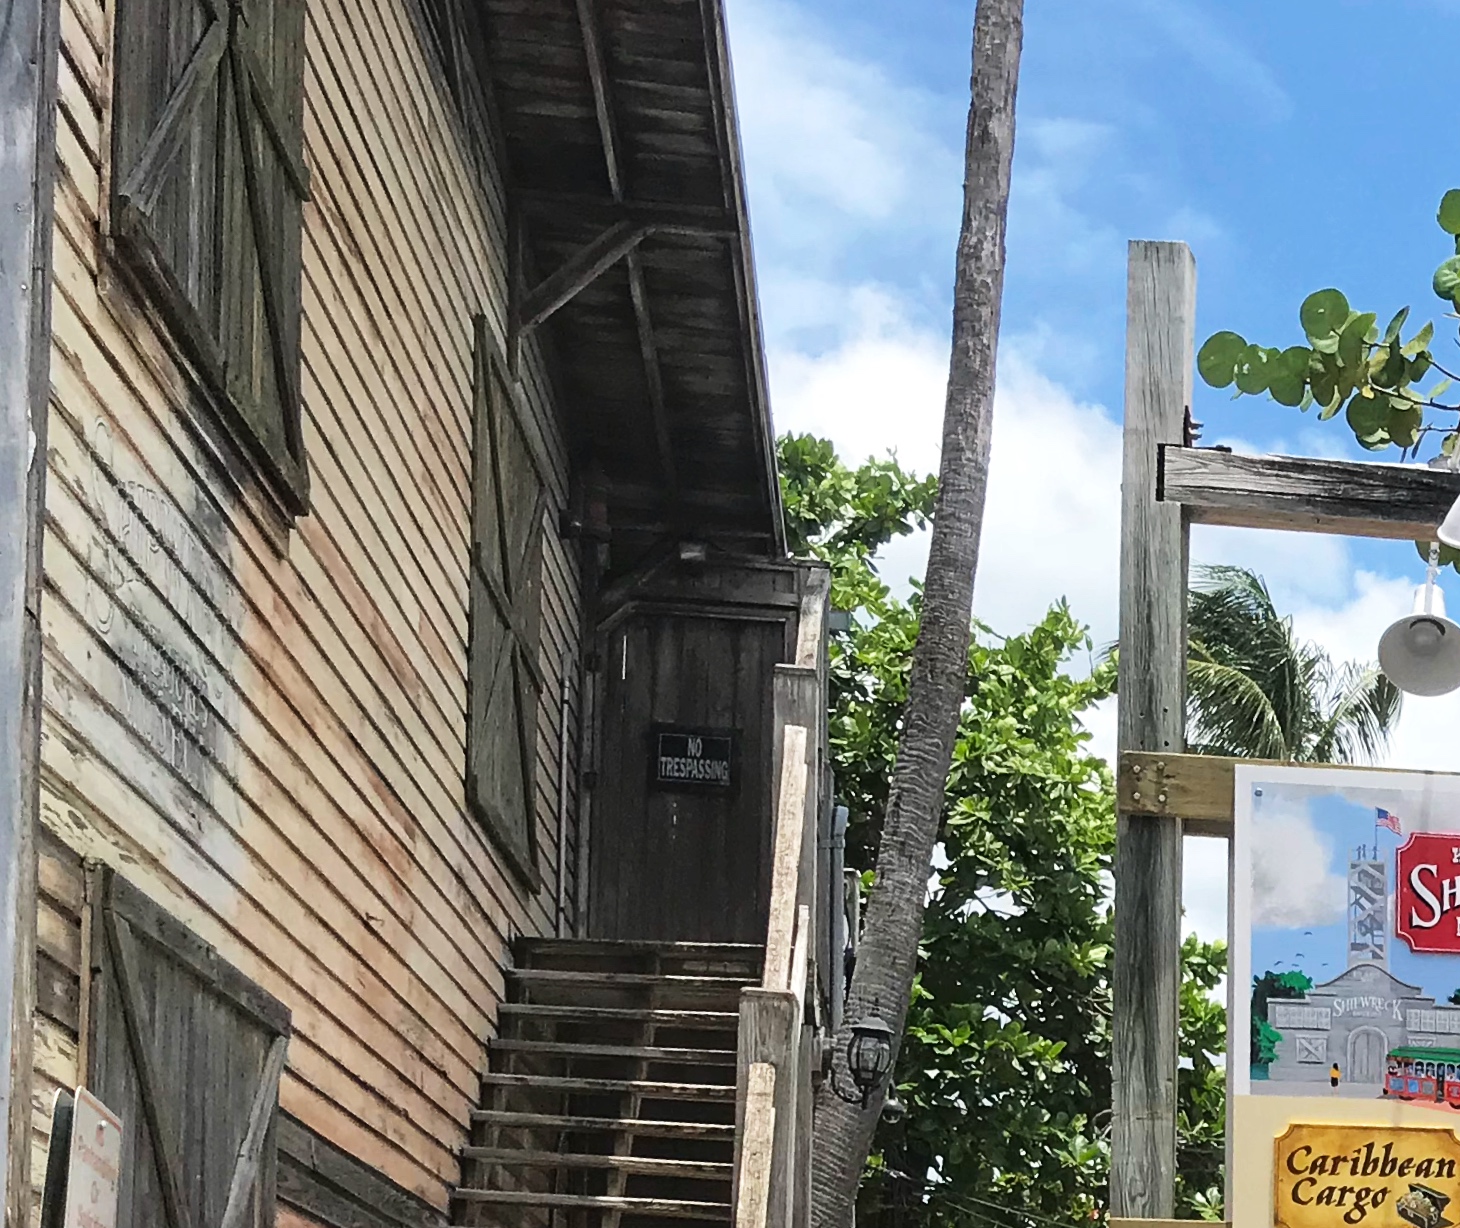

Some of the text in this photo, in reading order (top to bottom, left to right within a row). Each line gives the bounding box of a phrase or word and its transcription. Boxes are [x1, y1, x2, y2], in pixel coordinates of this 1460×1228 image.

[687, 737, 703, 758] NO
[660, 756, 729, 780] TRESPASSING
[1285, 1140, 1457, 1179] Caribbean
[1290, 1176, 1391, 1226] Cargo
